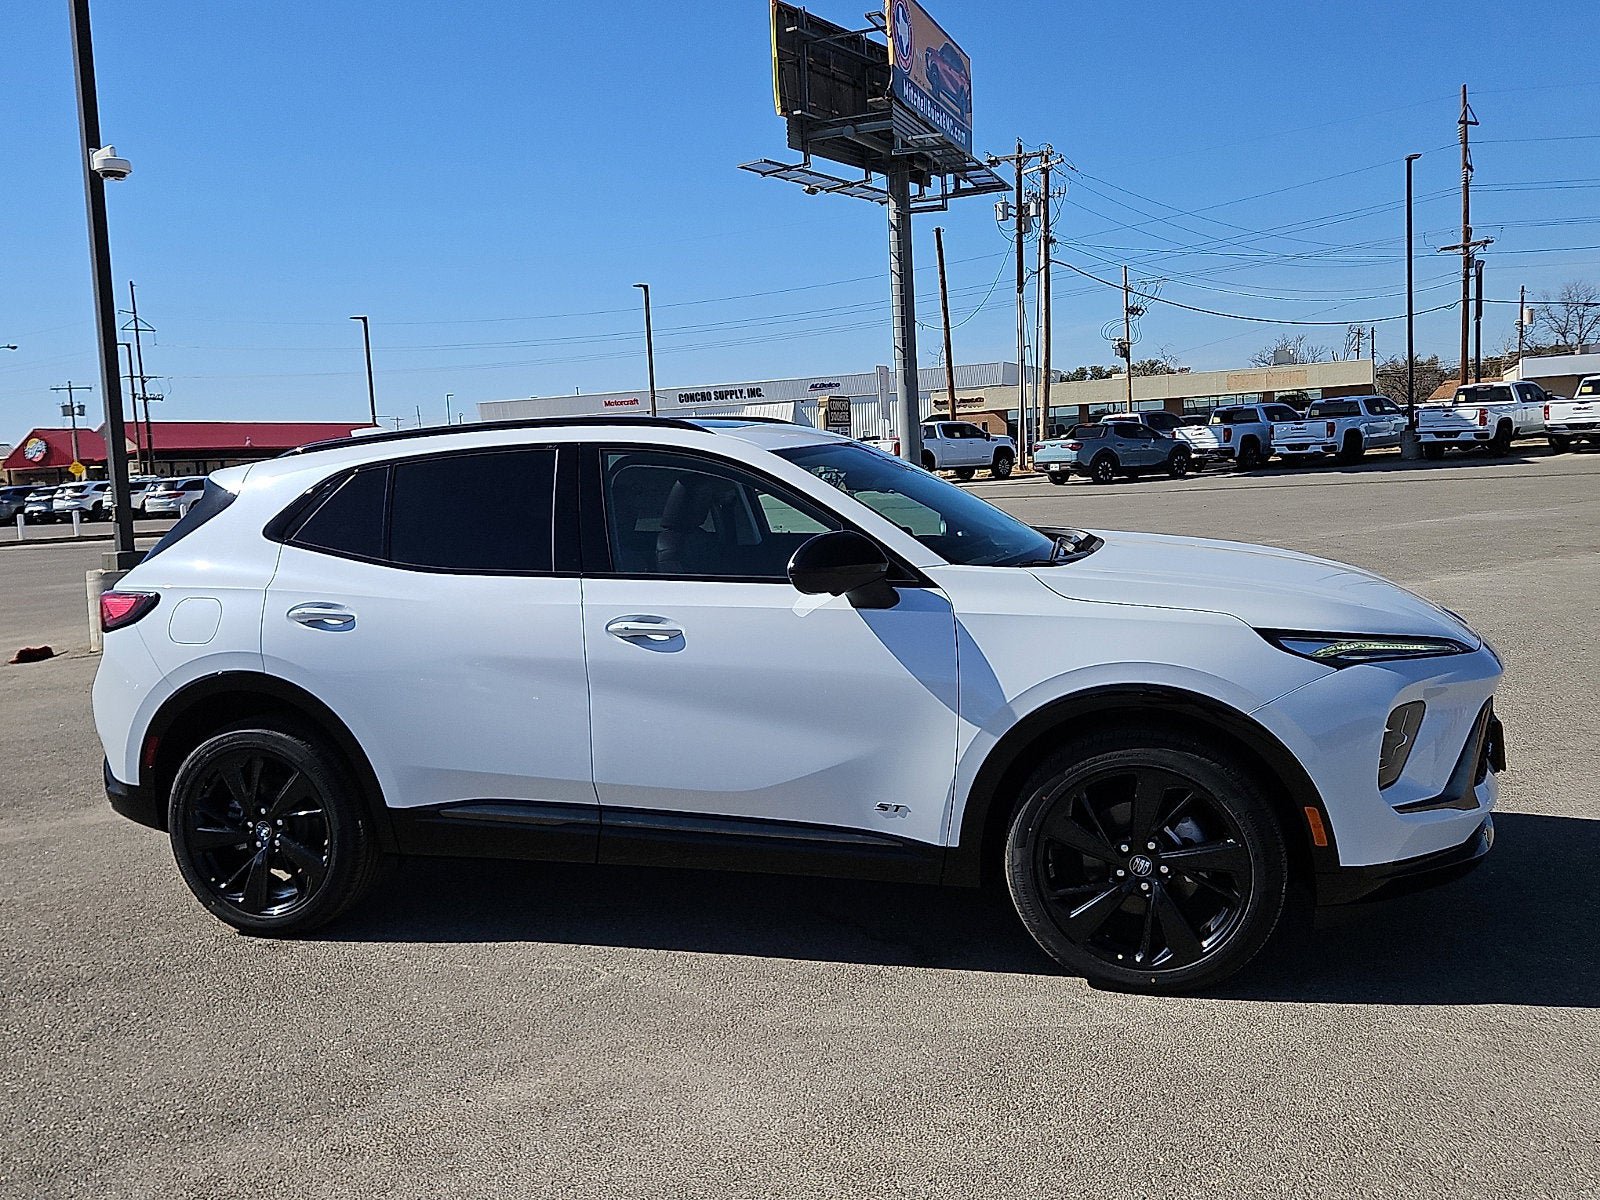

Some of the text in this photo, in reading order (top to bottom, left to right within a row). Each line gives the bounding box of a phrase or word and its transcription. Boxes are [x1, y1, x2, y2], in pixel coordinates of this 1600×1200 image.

[678, 387, 765, 404] CONCHO SUPPLY, INC.
[603, 397, 640, 408] Motorcraft
[874, 801, 910, 813] ST
